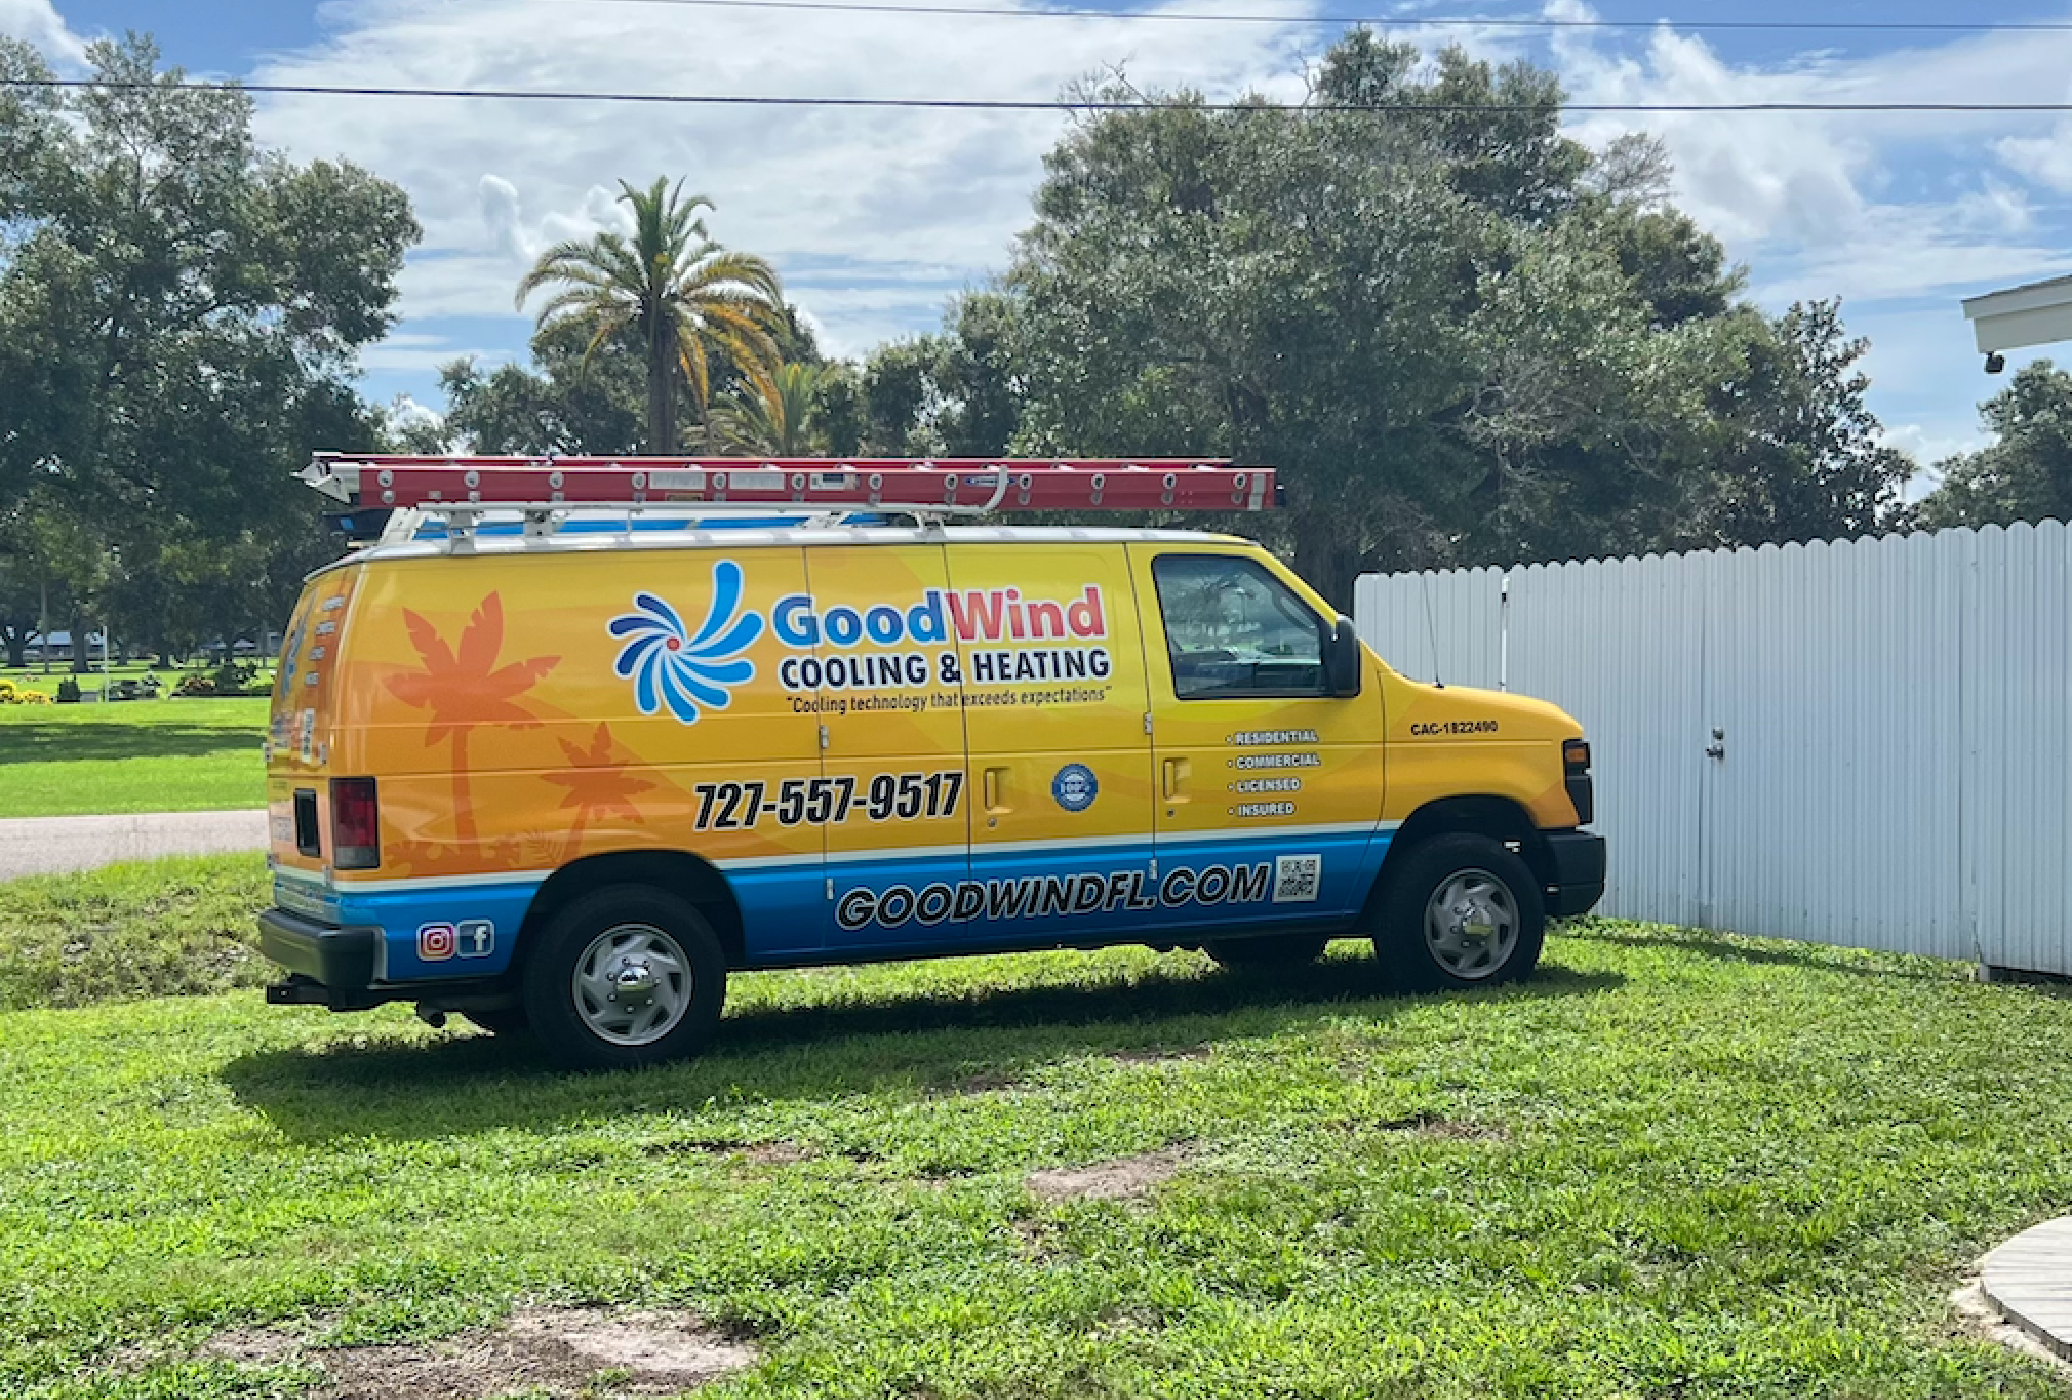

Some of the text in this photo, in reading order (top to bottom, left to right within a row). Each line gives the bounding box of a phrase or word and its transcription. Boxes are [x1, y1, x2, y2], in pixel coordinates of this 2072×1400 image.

[771, 585, 1107, 645] GoodWind
[781, 649, 1110, 690] COOLING & HEATING
[851, 694, 927, 712] technology
[931, 691, 959, 708] that
[961, 689, 1018, 706] exceeds
[1234, 730, 1319, 745] RESIDENTIAL
[1236, 753, 1321, 770] COMMERCIAL
[1236, 778, 1301, 793] LICENSED
[694, 772, 964, 830] 727-557-9517
[1236, 802, 1296, 817] INSURED
[836, 862, 1272, 930] GOODWINDFL.COM
